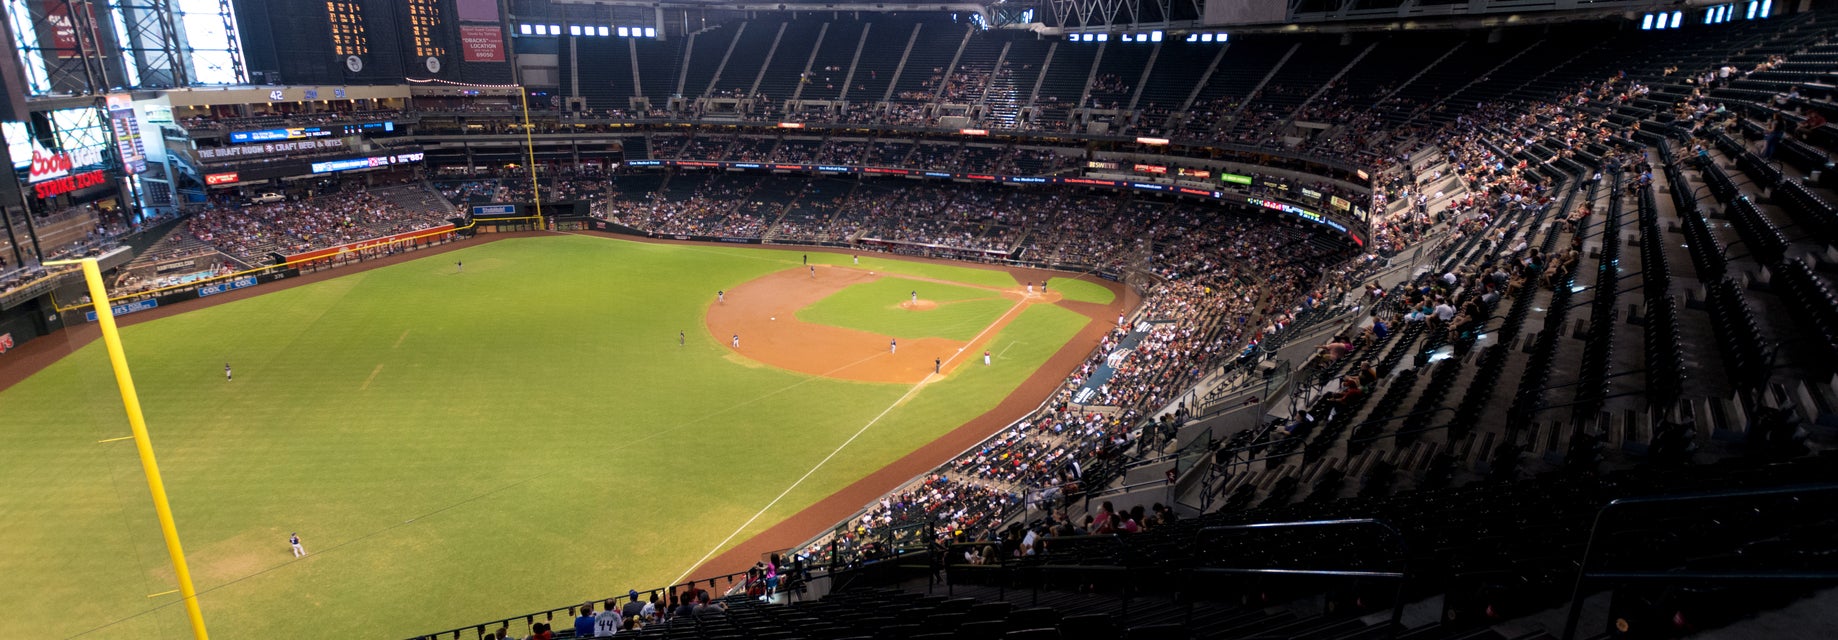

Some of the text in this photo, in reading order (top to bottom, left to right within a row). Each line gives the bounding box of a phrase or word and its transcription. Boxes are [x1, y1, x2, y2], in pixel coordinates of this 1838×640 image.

[269, 90, 284, 100] 42
[197, 148, 214, 158] THE
[216, 146, 240, 157] DRAFT
[241, 144, 264, 155] ROOM
[275, 142, 298, 152] CRAFT
[299, 140, 316, 150] BEER
[31, 150, 72, 176] Coors
[34, 169, 105, 199] STRIKE ZONE
[202, 286, 220, 294] COX
[599, 620, 613, 631] 44
